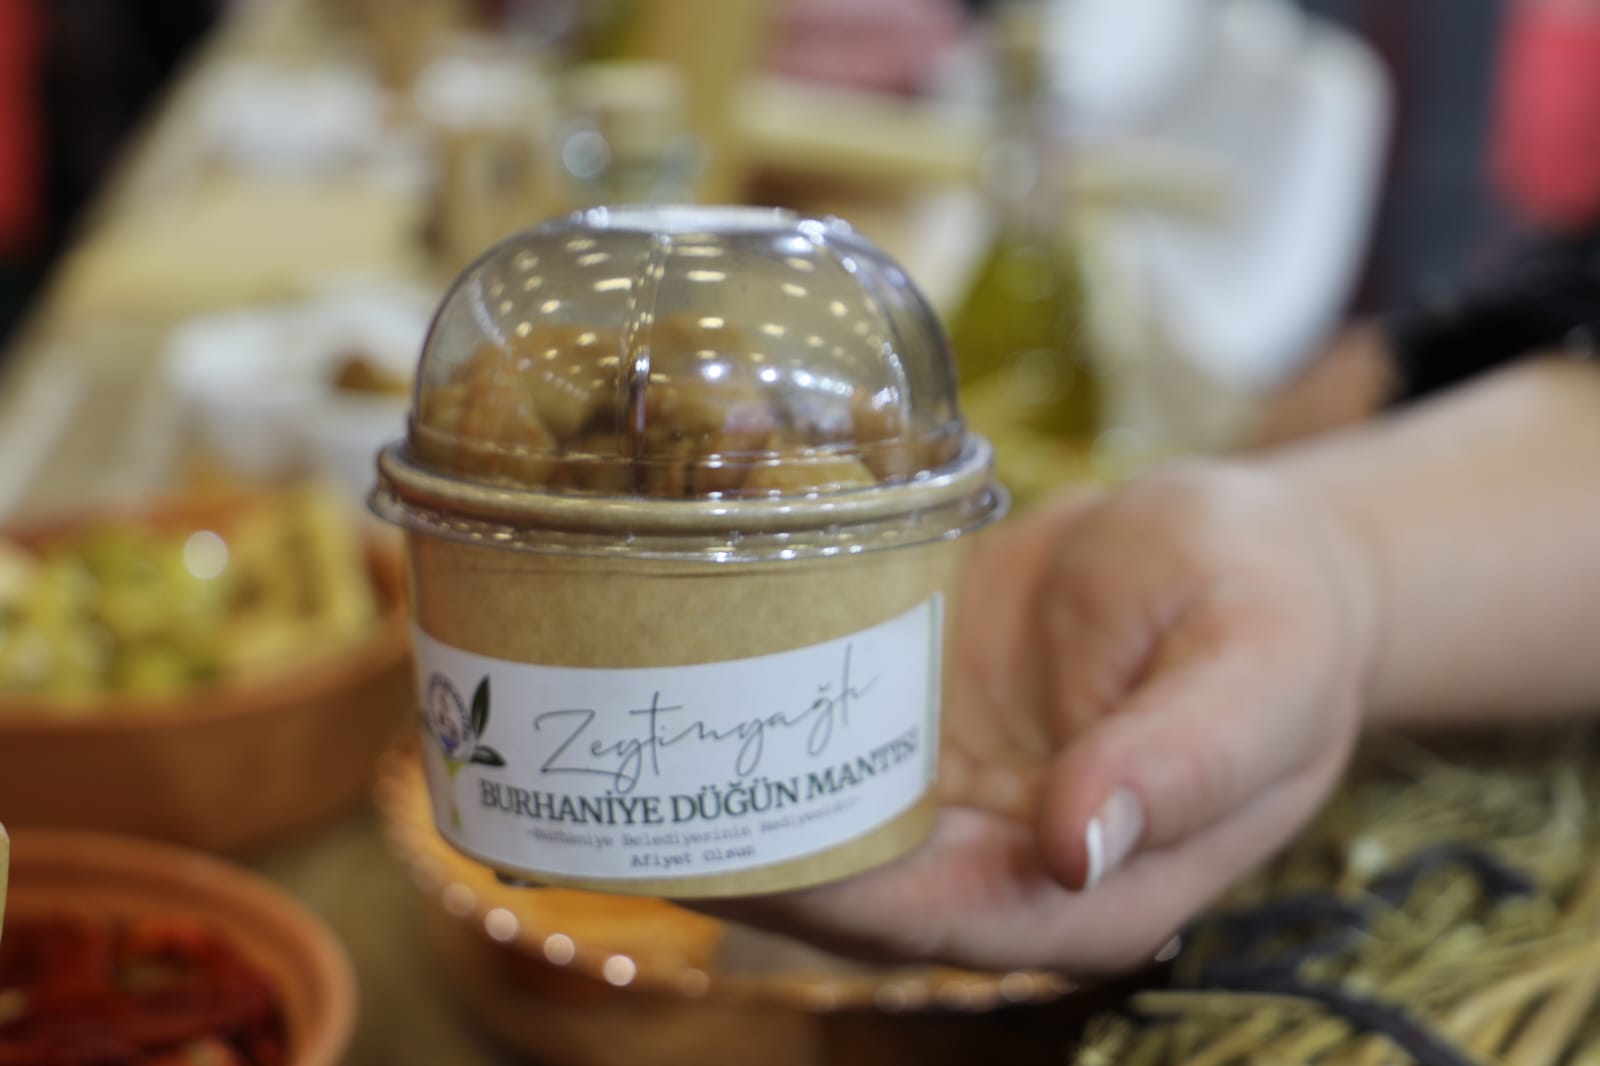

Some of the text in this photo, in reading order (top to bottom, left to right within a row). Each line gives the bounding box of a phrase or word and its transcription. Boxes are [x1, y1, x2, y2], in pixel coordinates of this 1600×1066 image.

[479, 777, 665, 825] BURHANİYE
[670, 776, 801, 823] DÜĞÜN
[630, 846, 757, 869] Afiyet Olsun
